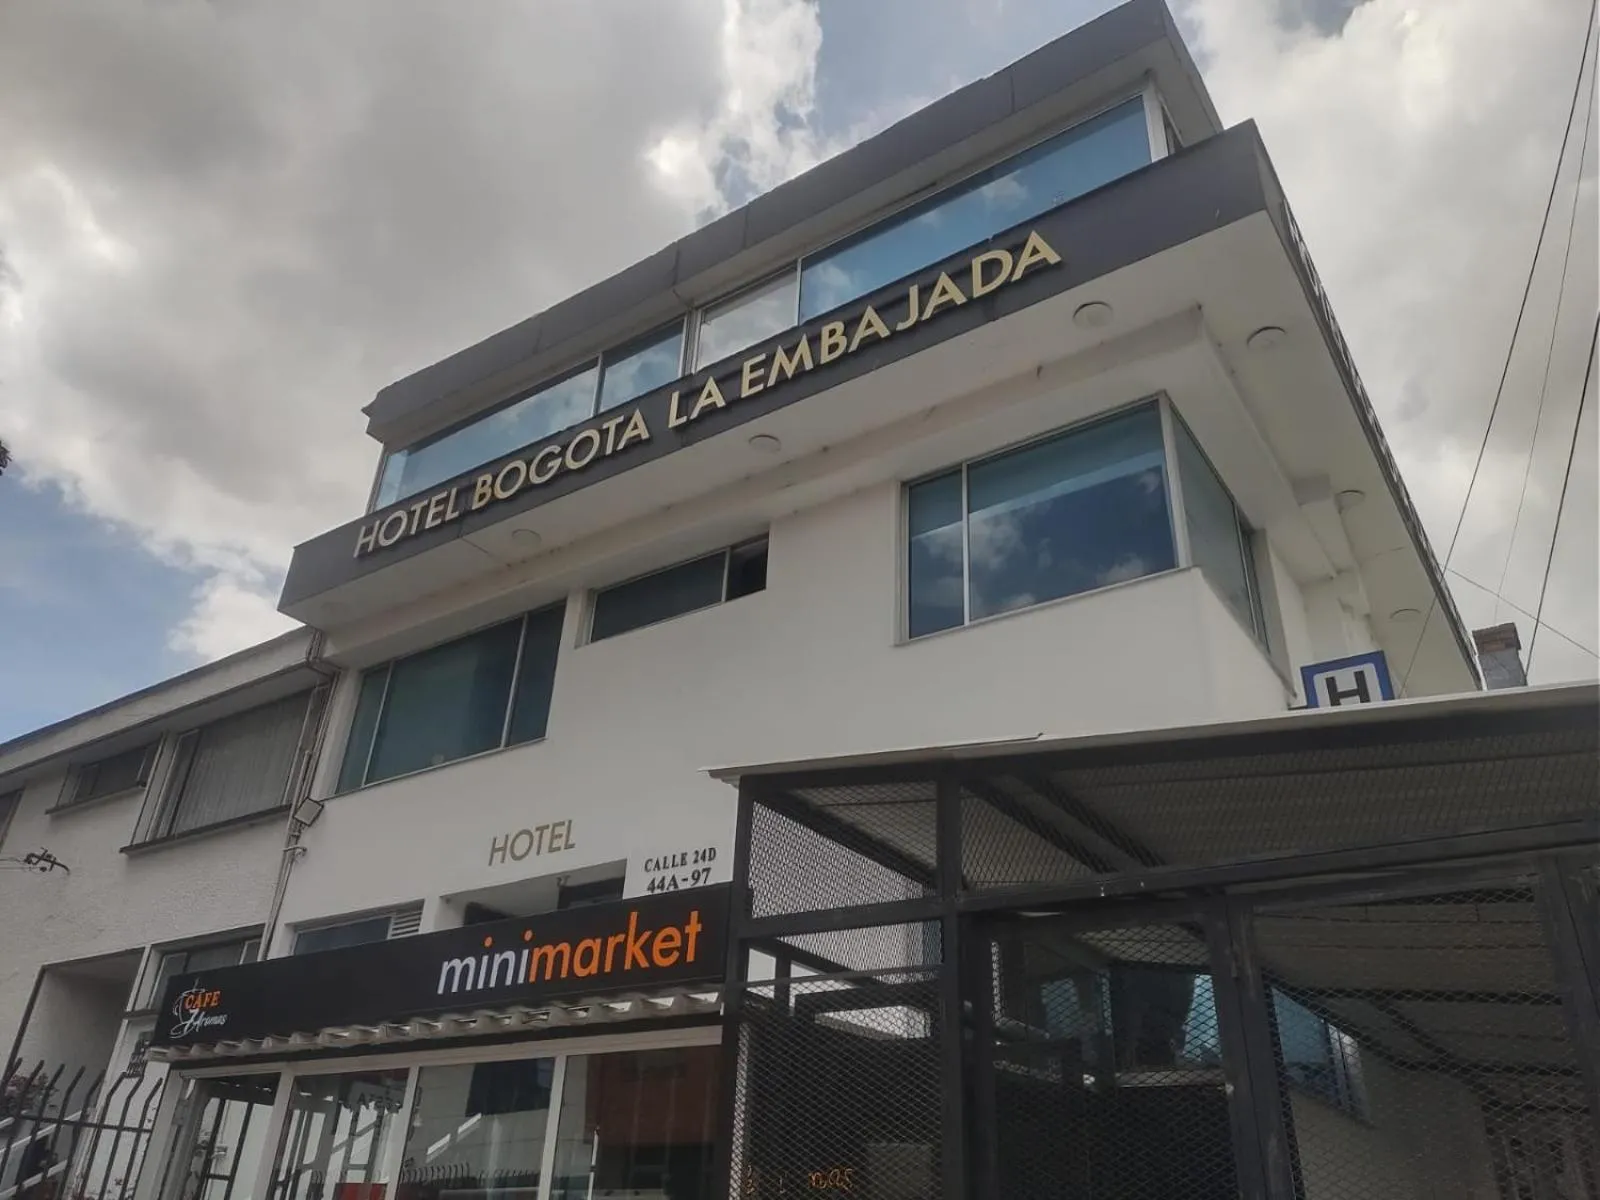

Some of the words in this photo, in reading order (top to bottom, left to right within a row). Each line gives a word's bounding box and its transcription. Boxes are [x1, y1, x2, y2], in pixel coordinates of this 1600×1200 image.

[353, 487, 461, 558] HOTEL
[471, 408, 650, 511] BOGOTA
[667, 376, 726, 429] LA
[740, 230, 1062, 398] EMBAJADA
[1325, 670, 1371, 706] H
[488, 819, 576, 866] HOTEL
[644, 852, 688, 873] CALLE
[693, 847, 717, 864] 24D
[647, 867, 712, 894] 44A-97
[437, 909, 702, 995] minimarket
